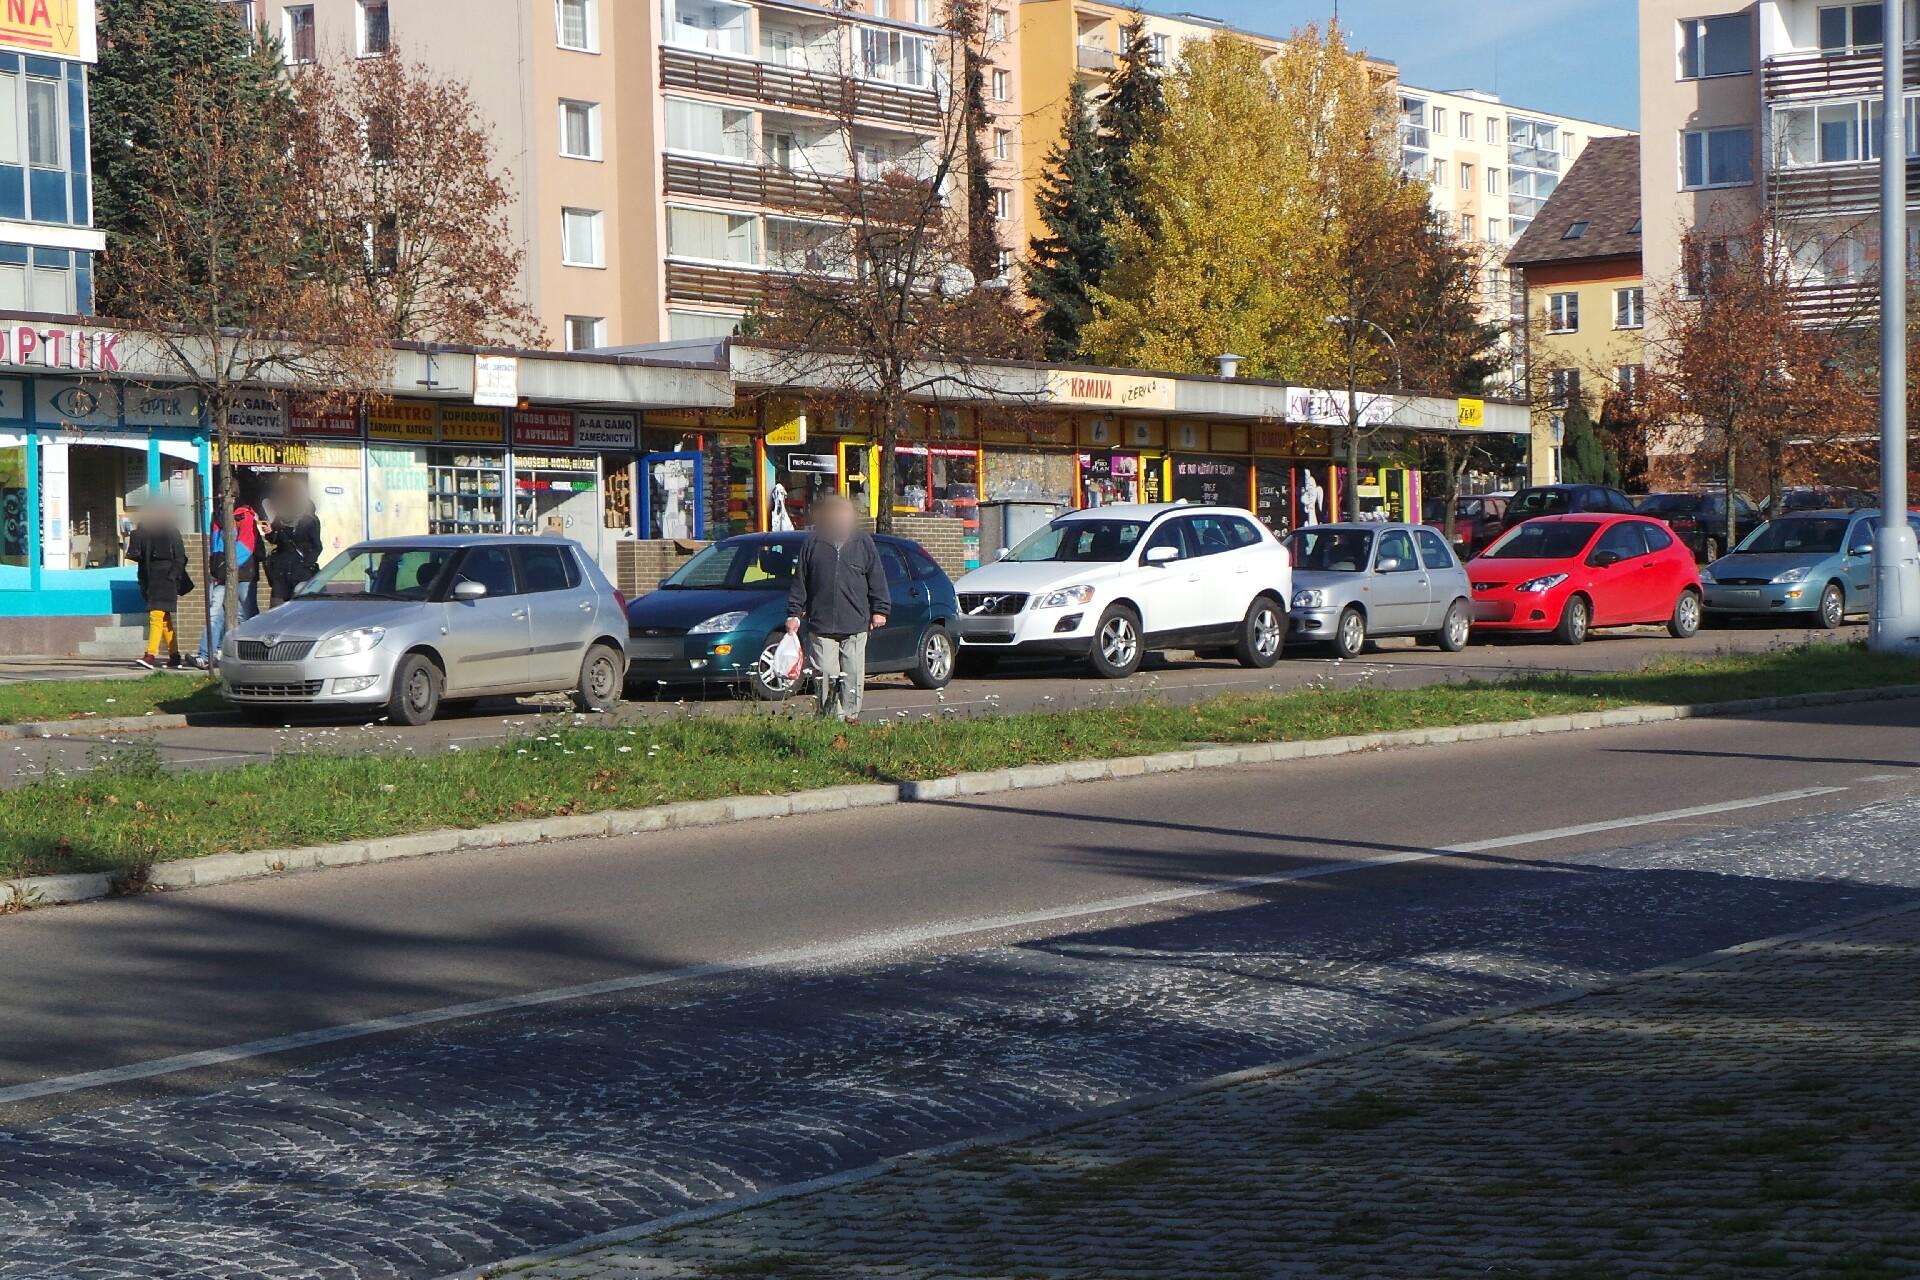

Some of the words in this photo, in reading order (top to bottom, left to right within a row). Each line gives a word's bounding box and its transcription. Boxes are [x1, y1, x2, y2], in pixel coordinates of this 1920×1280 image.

[0, 326, 120, 370] PTIK
[1071, 377, 1112, 400] KRMIVA
[369, 403, 432, 420] ELEKTRO
[604, 419, 632, 430] GAMO
